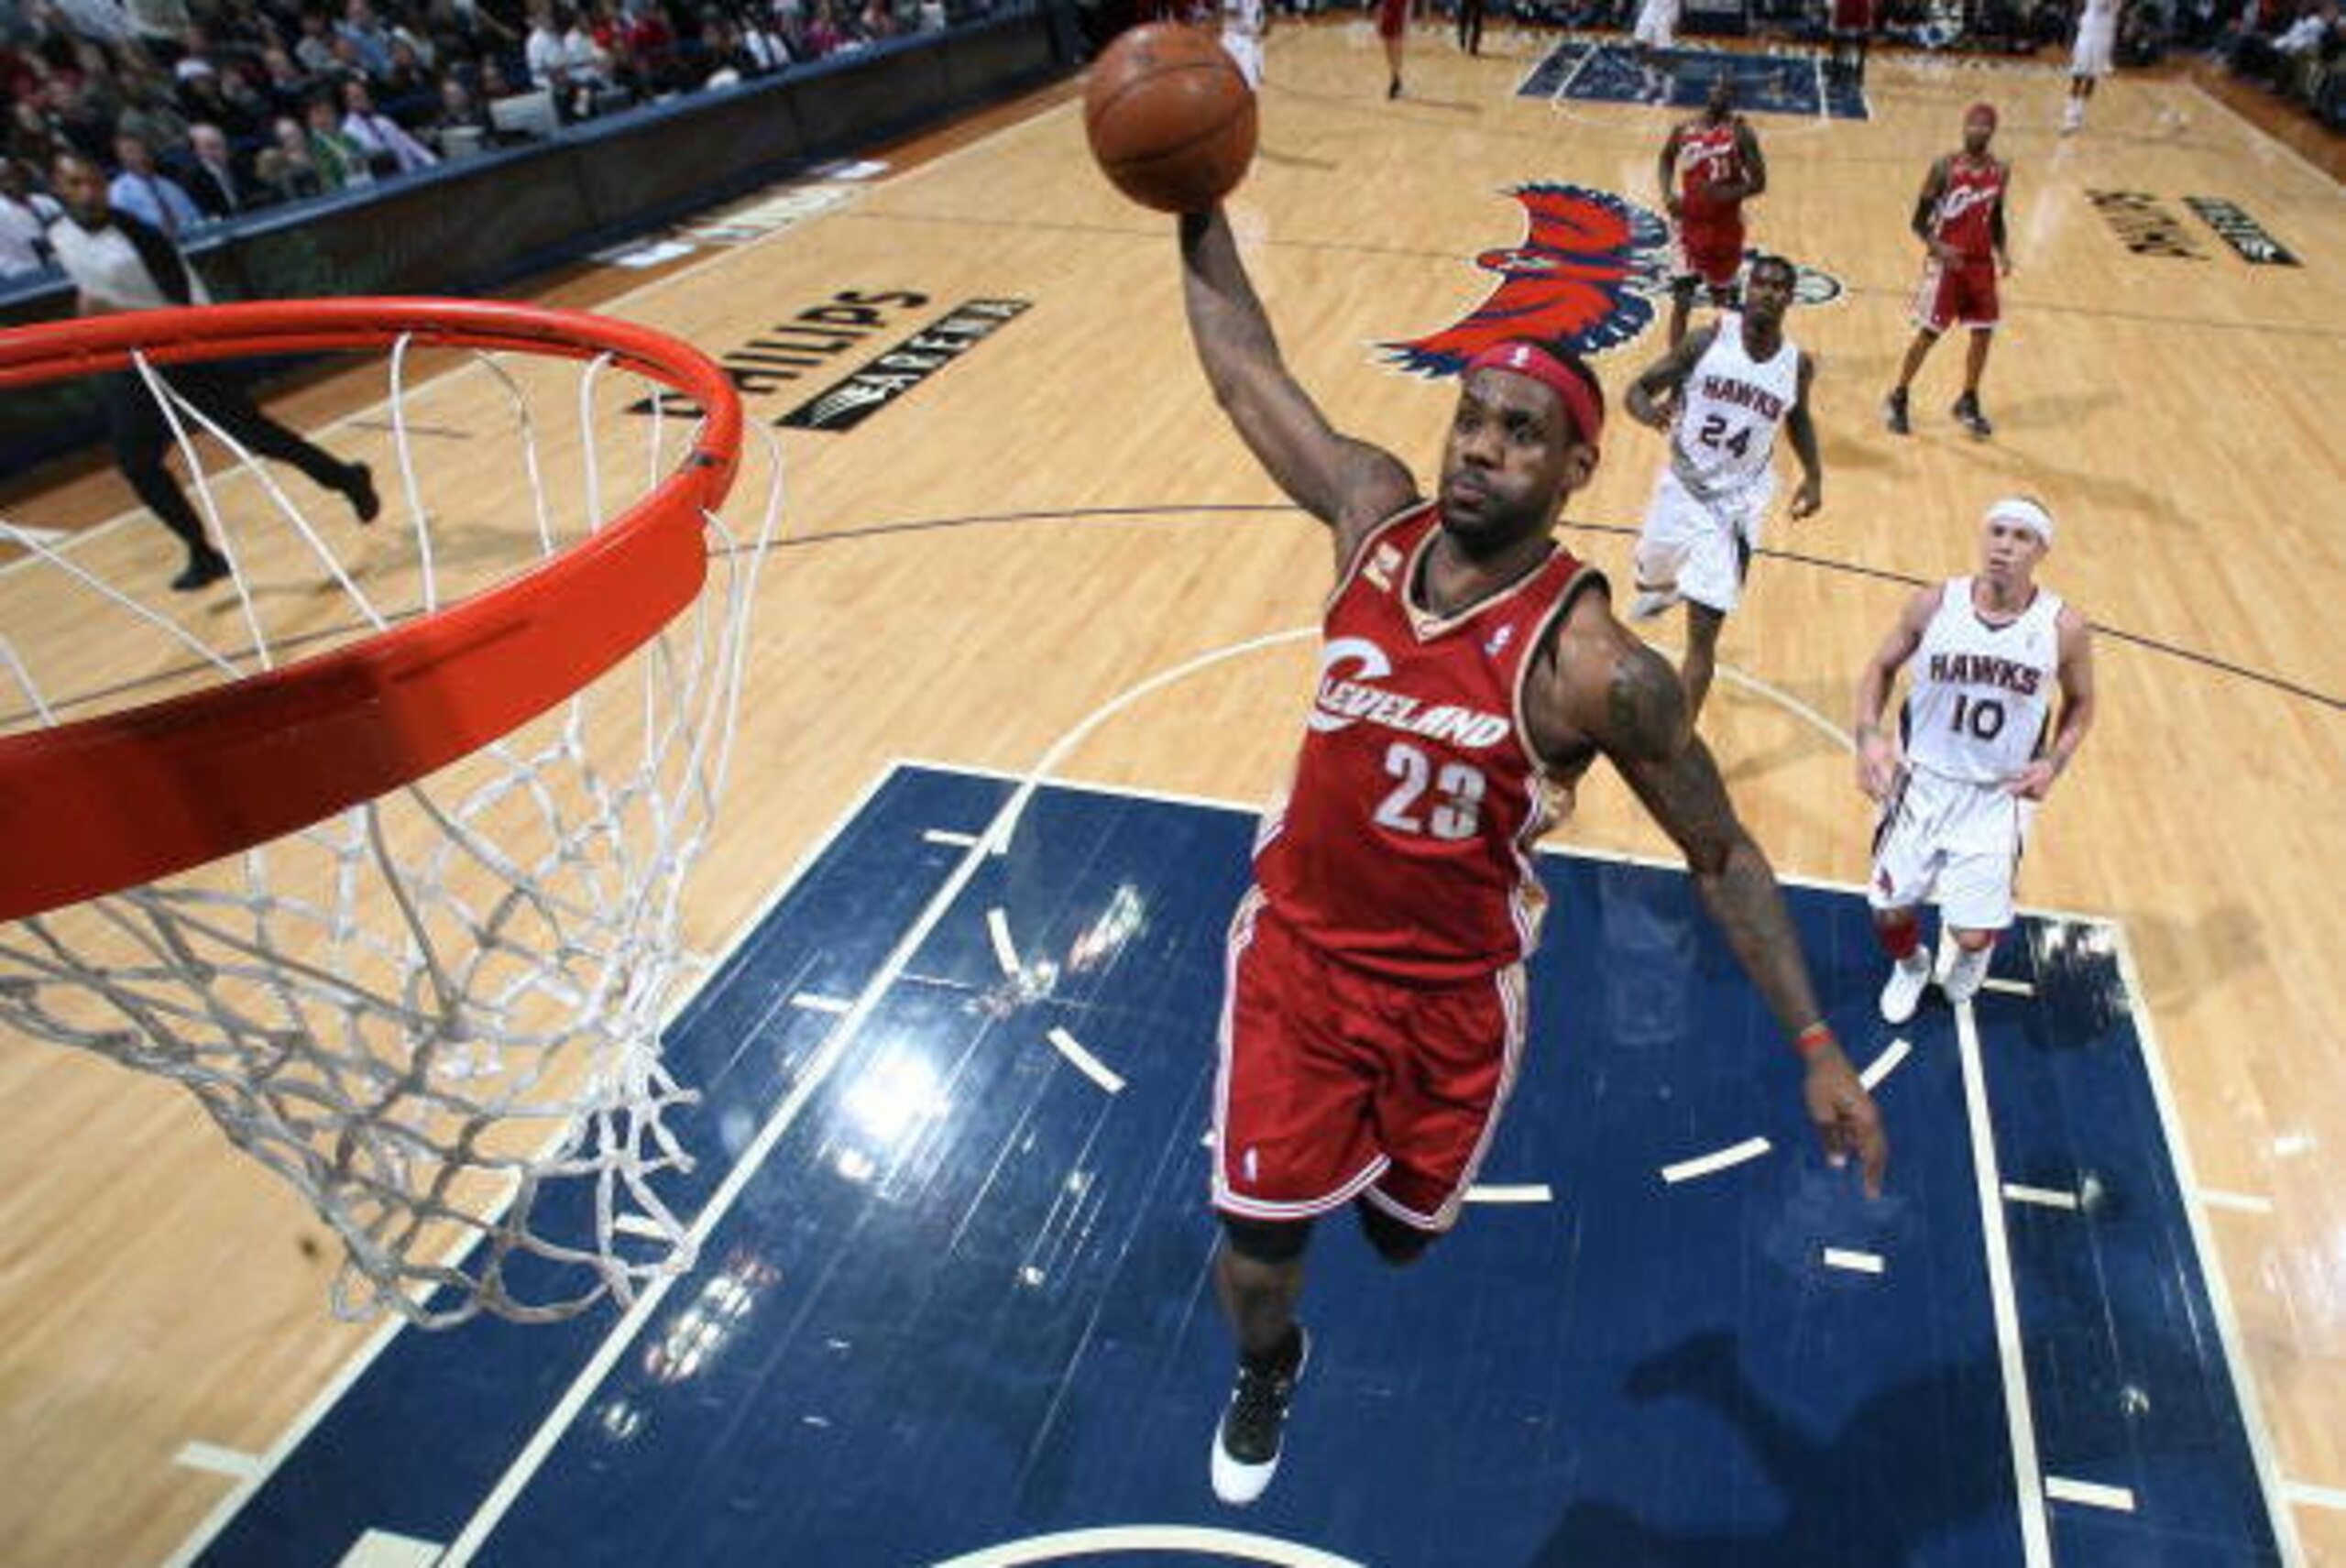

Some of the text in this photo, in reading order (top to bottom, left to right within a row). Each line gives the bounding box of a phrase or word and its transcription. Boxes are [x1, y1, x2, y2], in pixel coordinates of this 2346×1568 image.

[1703, 376, 1785, 422] HAWKS
[1701, 414, 1752, 459] 24
[1930, 653, 2042, 696] HAWKS
[1952, 694, 2006, 740] 10
[1374, 742, 1486, 840] 23
